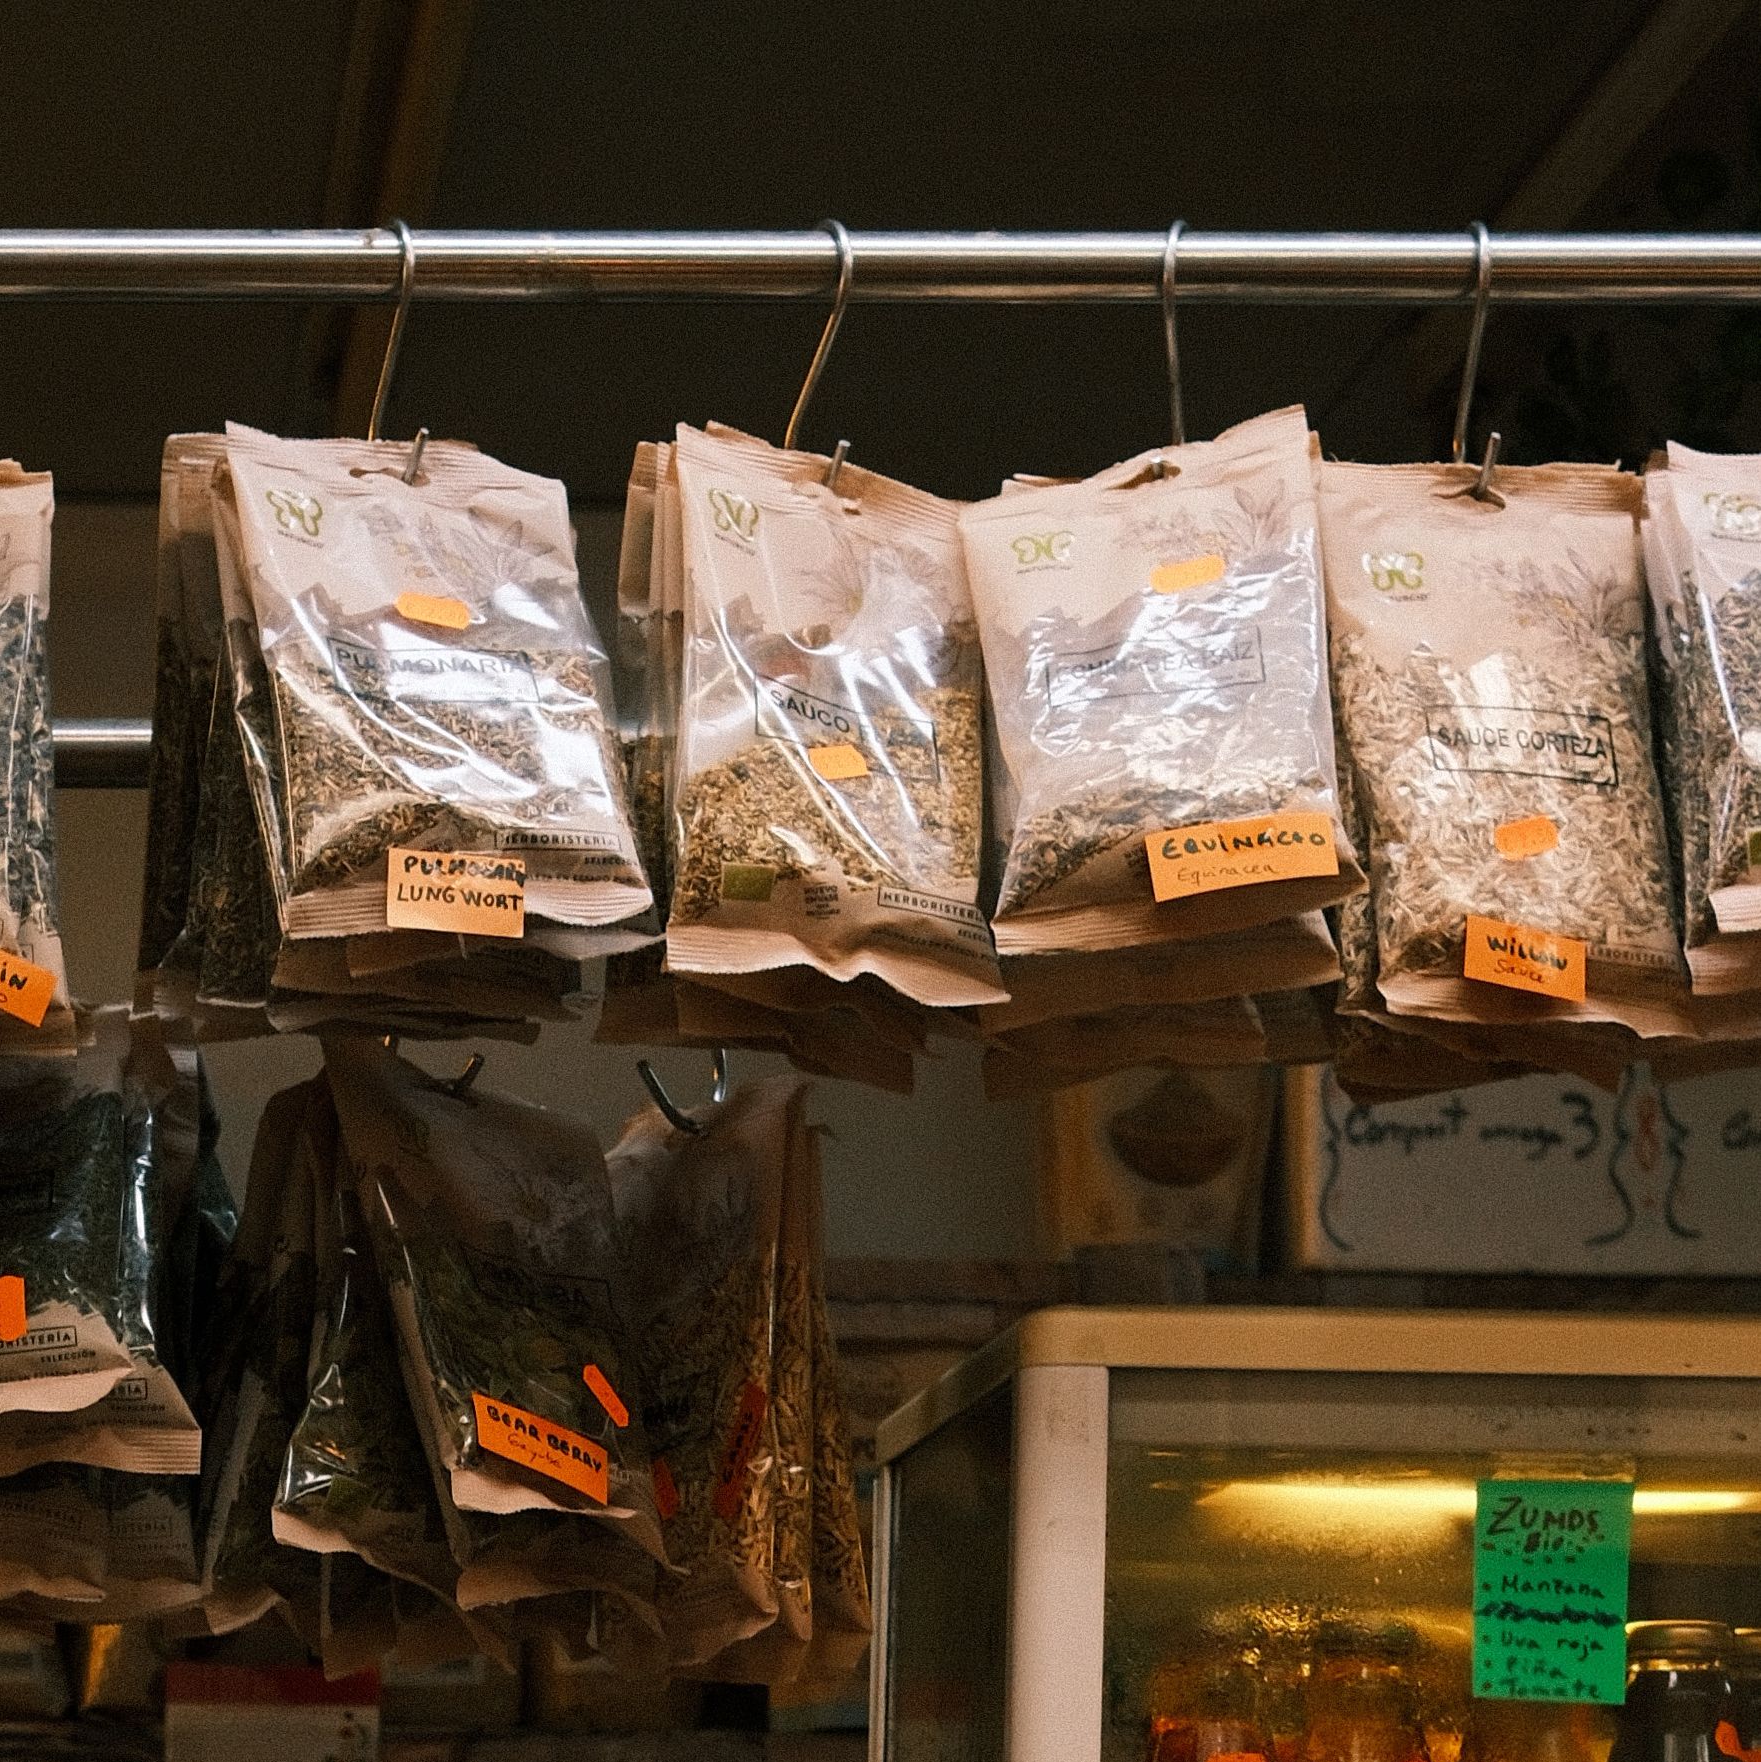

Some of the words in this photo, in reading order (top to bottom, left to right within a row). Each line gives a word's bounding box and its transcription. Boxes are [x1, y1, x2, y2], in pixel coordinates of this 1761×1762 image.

[1437, 726, 1512, 751] SAUCE
[1515, 729, 1610, 760] CORTEZA
[396, 883, 456, 905] LUNG
[462, 890, 523, 911] WORT
